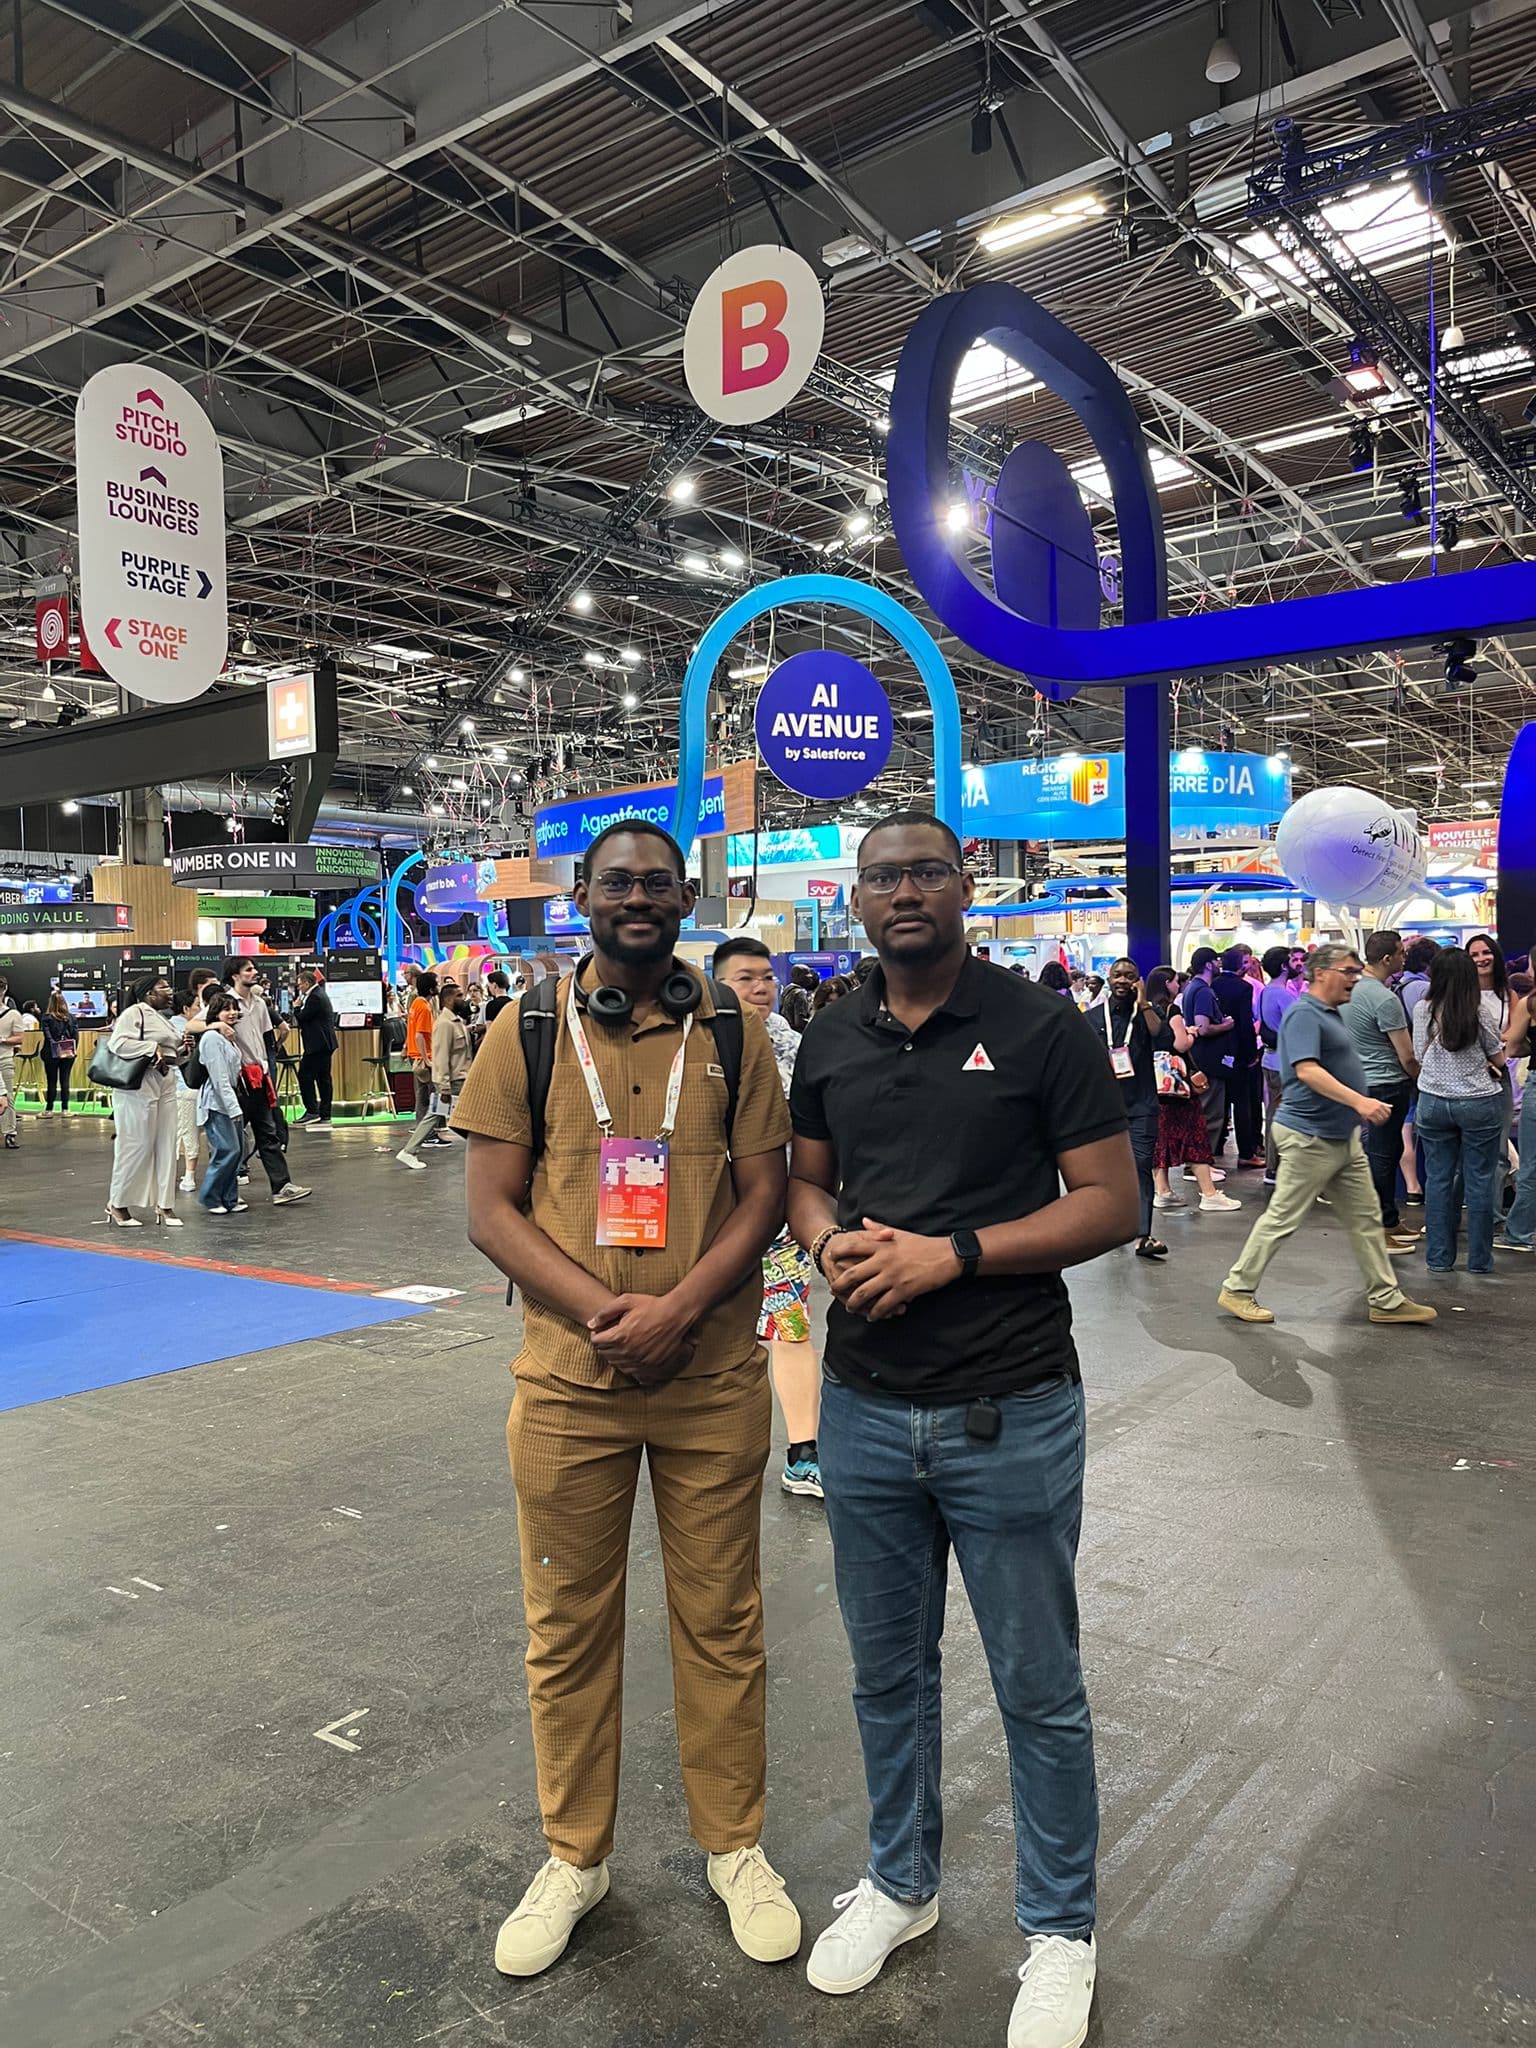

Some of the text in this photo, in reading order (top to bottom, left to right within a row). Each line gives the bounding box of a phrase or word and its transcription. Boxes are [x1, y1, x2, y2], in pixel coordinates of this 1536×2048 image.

[721, 279, 790, 396] B
[123, 406, 179, 438] PITCH
[116, 423, 187, 457] STUDIO
[107, 480, 199, 518] BUSINESS
[109, 499, 198, 536] LOUNGES
[121, 551, 190, 581] PURPLE
[126, 570, 187, 598] STAGE
[128, 618, 188, 645] STAGE
[138, 639, 178, 660] ONE
[811, 683, 838, 708] AI
[771, 712, 879, 739] AVENUE
[785, 746, 866, 761] by Salesforce
[1022, 761, 1063, 776] RÉGIO
[1042, 774, 1068, 785] SUD
[1213, 764, 1254, 796] D'IA
[580, 805, 669, 835] Agentforce
[1432, 828, 1496, 841] NOUVELLE-
[1437, 838, 1497, 848] AQUITANE
[315, 847, 364, 859] INNOVATION
[316, 856, 363, 867] ATTRACTING
[1351, 845, 1376, 859] Detect
[173, 852, 296, 874] NUMBER ONE IN
[316, 865, 355, 874] UNICORN
[809, 886, 838, 896] SNCF
[33, 911, 89, 923] VALUE.
[549, 905, 569, 915] aws
